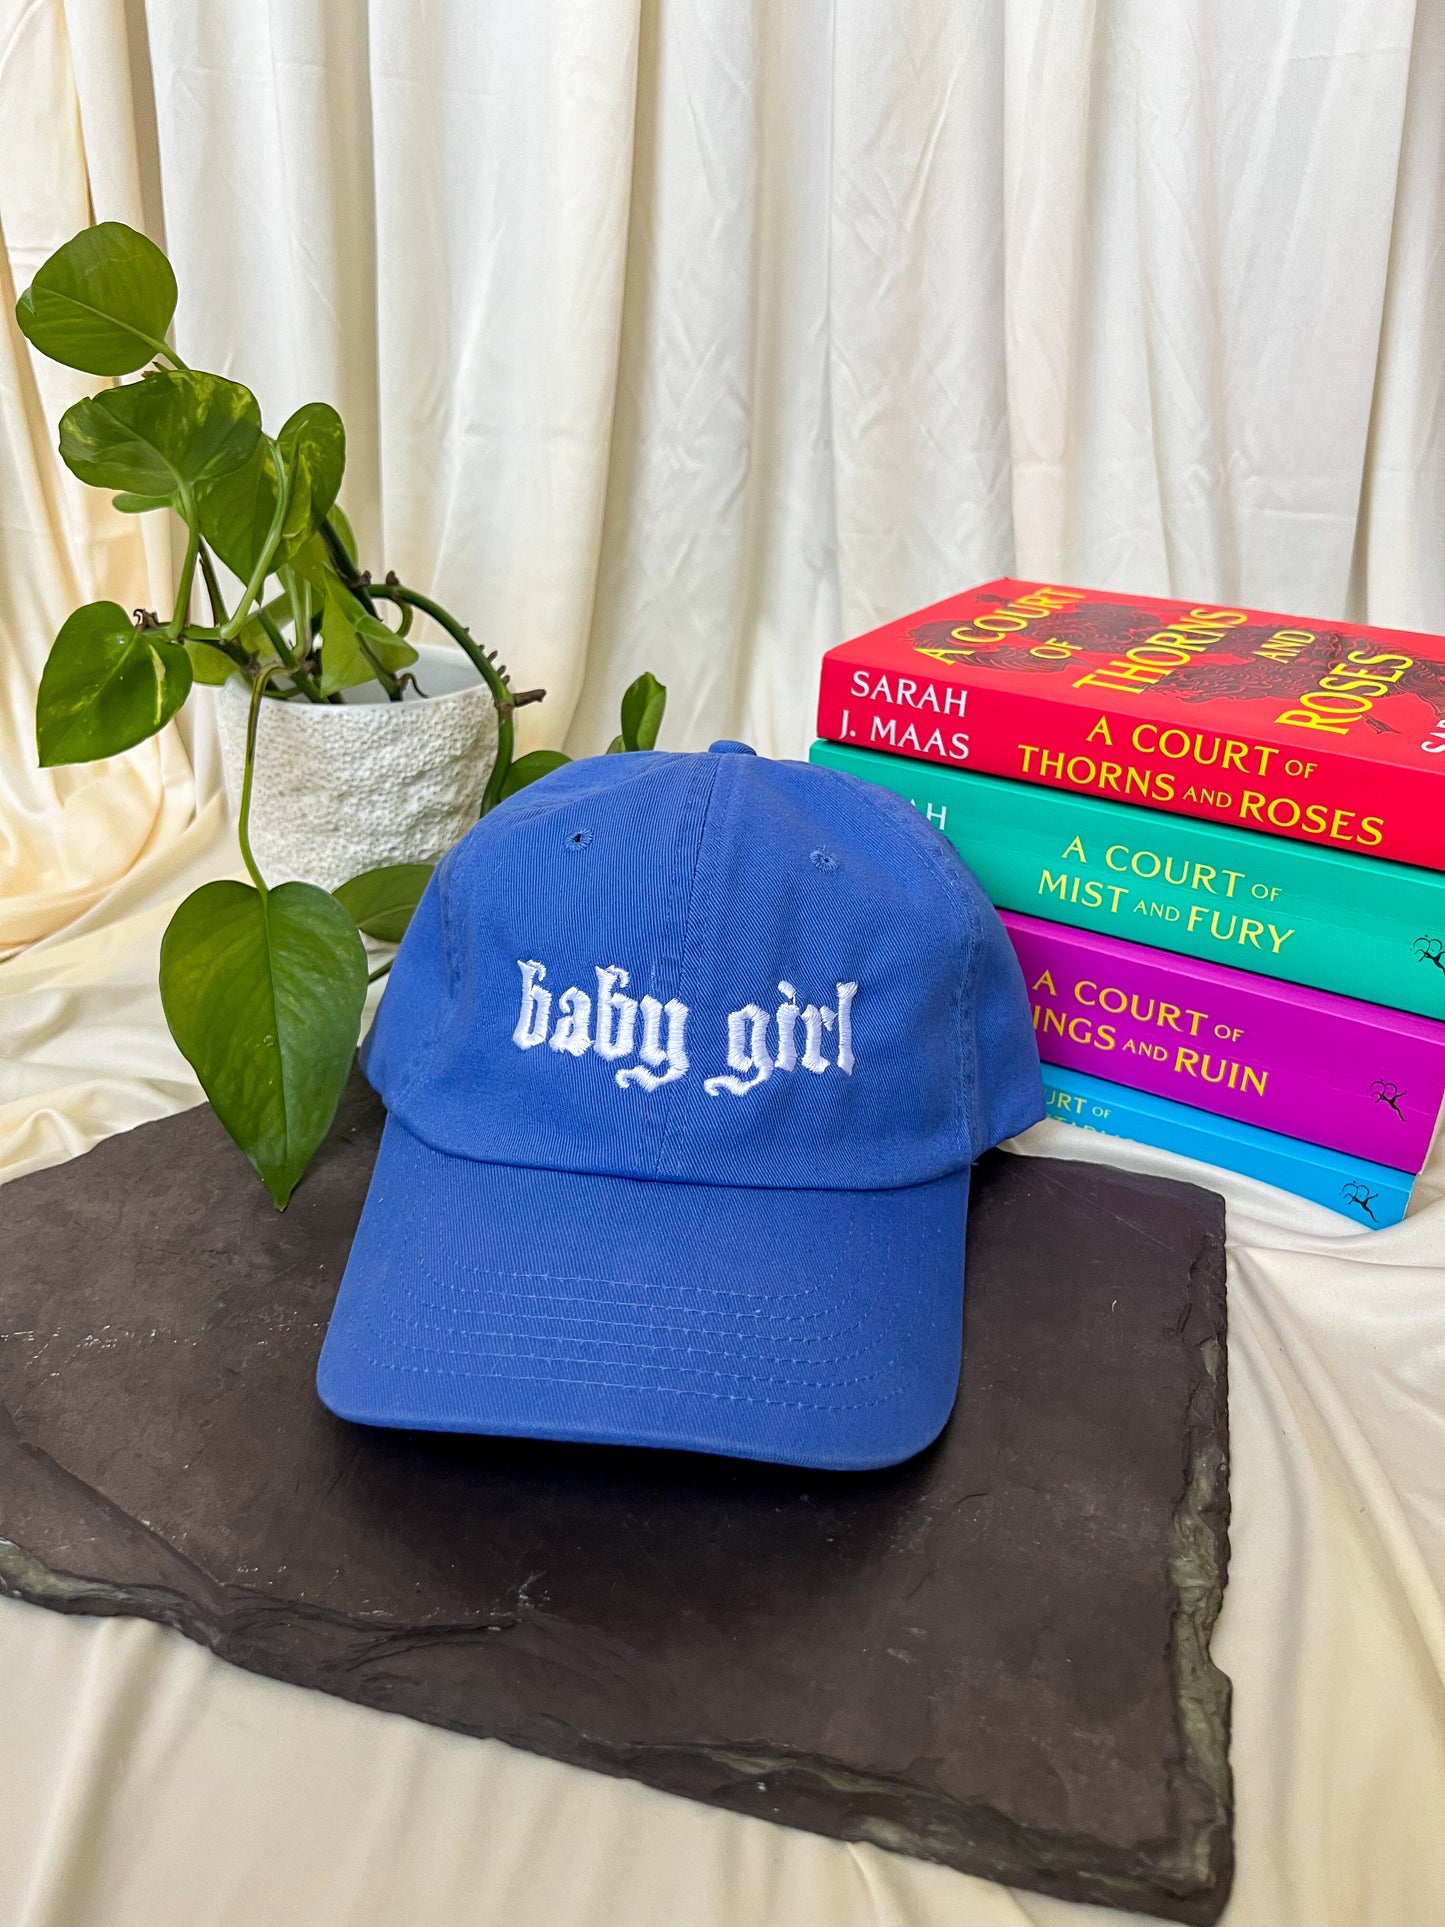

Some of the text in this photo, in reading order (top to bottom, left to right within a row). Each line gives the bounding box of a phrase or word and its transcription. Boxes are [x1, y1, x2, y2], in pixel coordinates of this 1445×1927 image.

[914, 587, 1086, 665] A COURT
[1029, 638, 1083, 660] OF
[1071, 607, 1248, 694] THORNS
[1253, 629, 1317, 664] AND
[850, 670, 968, 718] SARAH
[1275, 649, 1415, 736] ROSES
[839, 709, 970, 760] J. MAAS
[1085, 715, 1318, 780] A COURT OF
[1017, 744, 1385, 847] THORNS AND ROSES
[1061, 836, 1283, 903] A COURT OF
[1037, 869, 1296, 954] MIST AND FURY
[512, 959, 858, 1097] baby girl
[1032, 969, 1244, 1043] A COURT OF
[1033, 1004, 1269, 1097] INGS AND RUIN
[1092, 1105, 1113, 1119] OF
